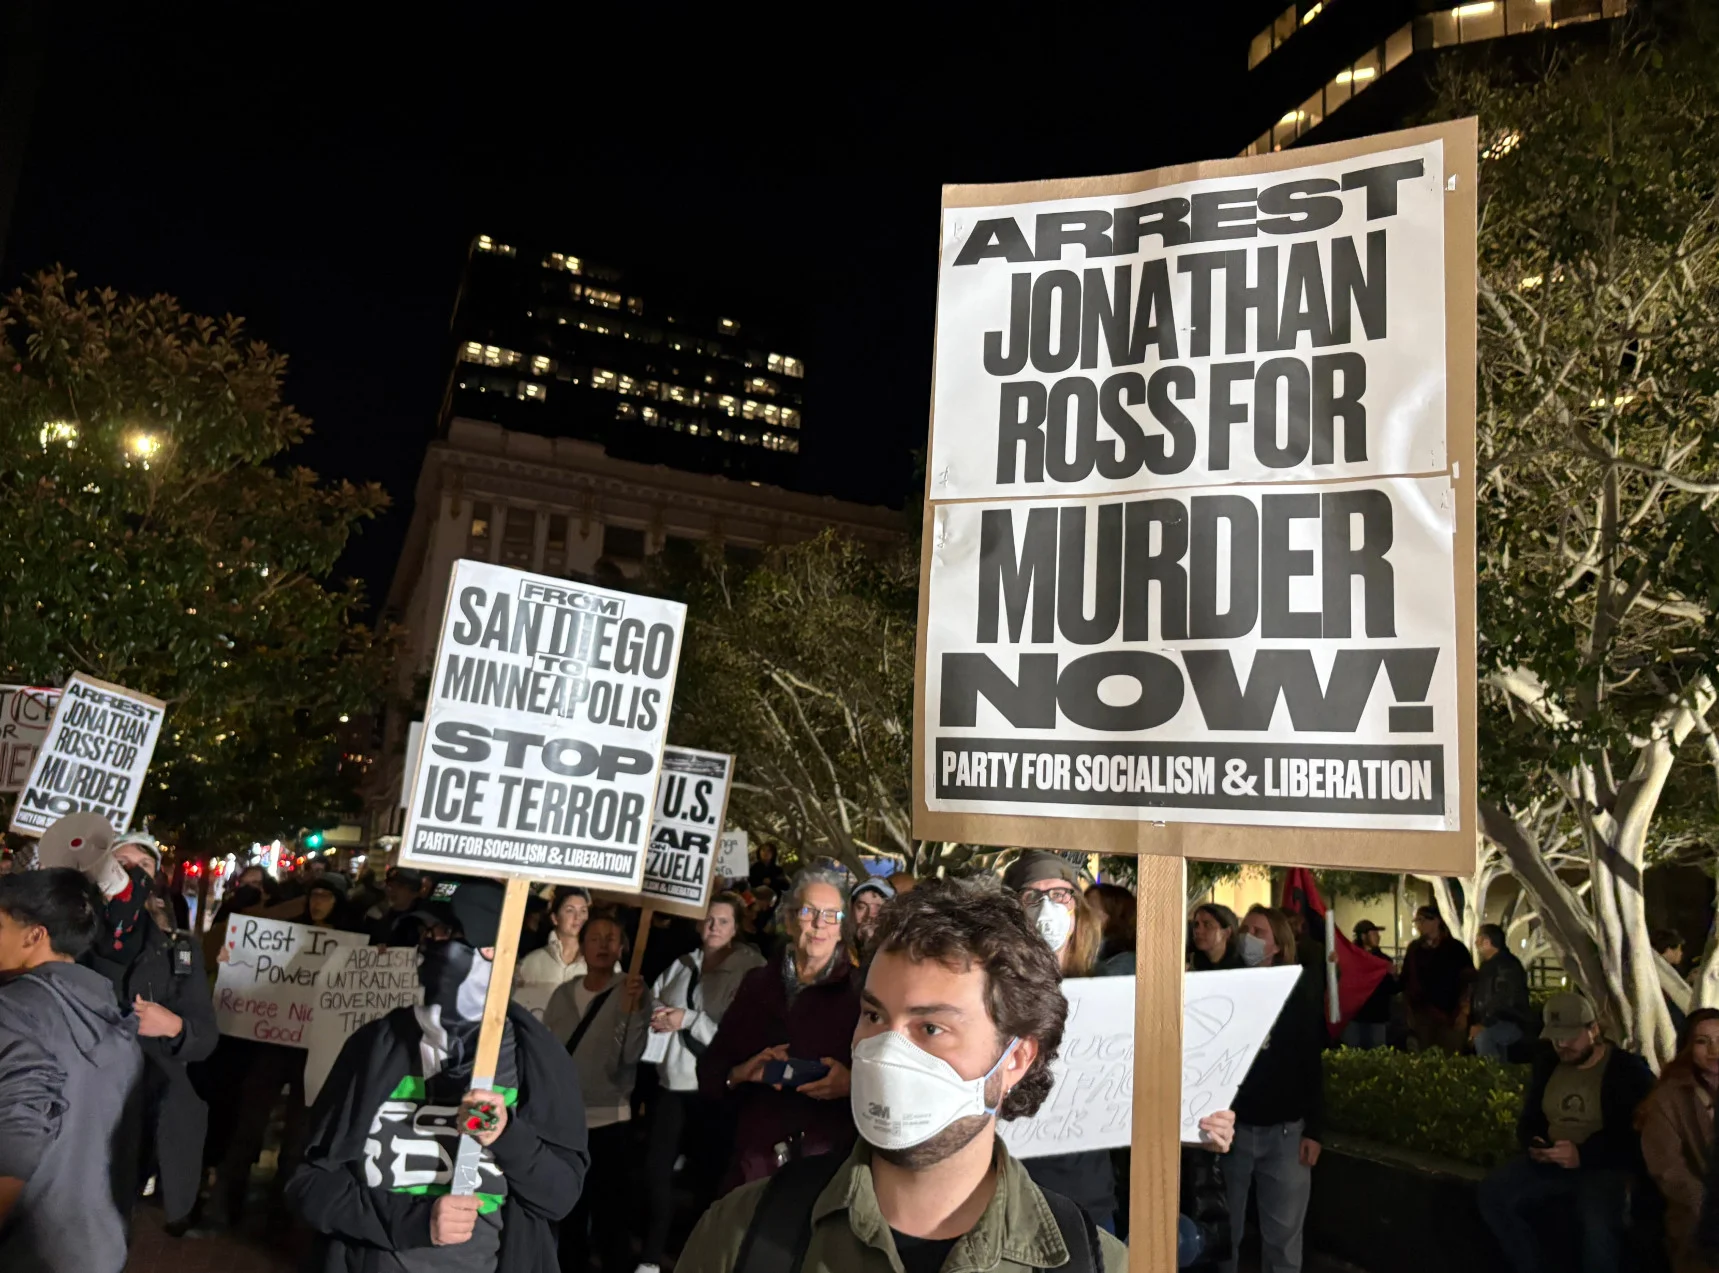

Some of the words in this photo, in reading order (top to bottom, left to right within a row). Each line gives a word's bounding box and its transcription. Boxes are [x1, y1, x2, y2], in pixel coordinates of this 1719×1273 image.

[953, 158, 1424, 266] ARREST
[983, 229, 1387, 376] JONATHAN
[996, 365, 1196, 485] ROSS
[1208, 351, 1368, 471] FOR
[977, 489, 1398, 645] MURDER
[524, 583, 618, 616] FROM
[453, 586, 545, 657] SAN
[550, 602, 675, 680] DIEGO
[538, 656, 584, 676] TO
[68, 683, 160, 721] ARREST
[441, 654, 661, 731] MINNEAPOLIS
[939, 647, 1440, 733] NOW!
[63, 701, 150, 747] JONATHAN
[55, 726, 105, 760] ROSS
[103, 739, 138, 771] FOR
[431, 722, 654, 782] STOP
[36, 755, 131, 808] MURDER
[942, 751, 1019, 787] PARTY
[1021, 752, 1071, 791] FOR
[1074, 754, 1215, 796] SOCIALISM
[1222, 758, 1258, 796] &
[1265, 757, 1432, 800] LIBERATION
[420, 765, 490, 828] ICE
[497, 774, 644, 845] TERROR
[663, 775, 715, 825] U.S.
[416, 830, 457, 851] PARTY
[457, 836, 484, 855] FOR
[483, 838, 546, 864] SOCIALISM
[548, 847, 563, 865] &
[564, 848, 632, 873] LIBERATION
[651, 825, 711, 854] AR
[646, 851, 704, 884] ZUELA
[242, 920, 295, 952] Rest
[255, 955, 320, 987] Power
[345, 949, 418, 969] ABOLISH
[220, 988, 280, 1017] Renee
[254, 1020, 304, 1043] Good
[868, 1101, 890, 1119] 3M
